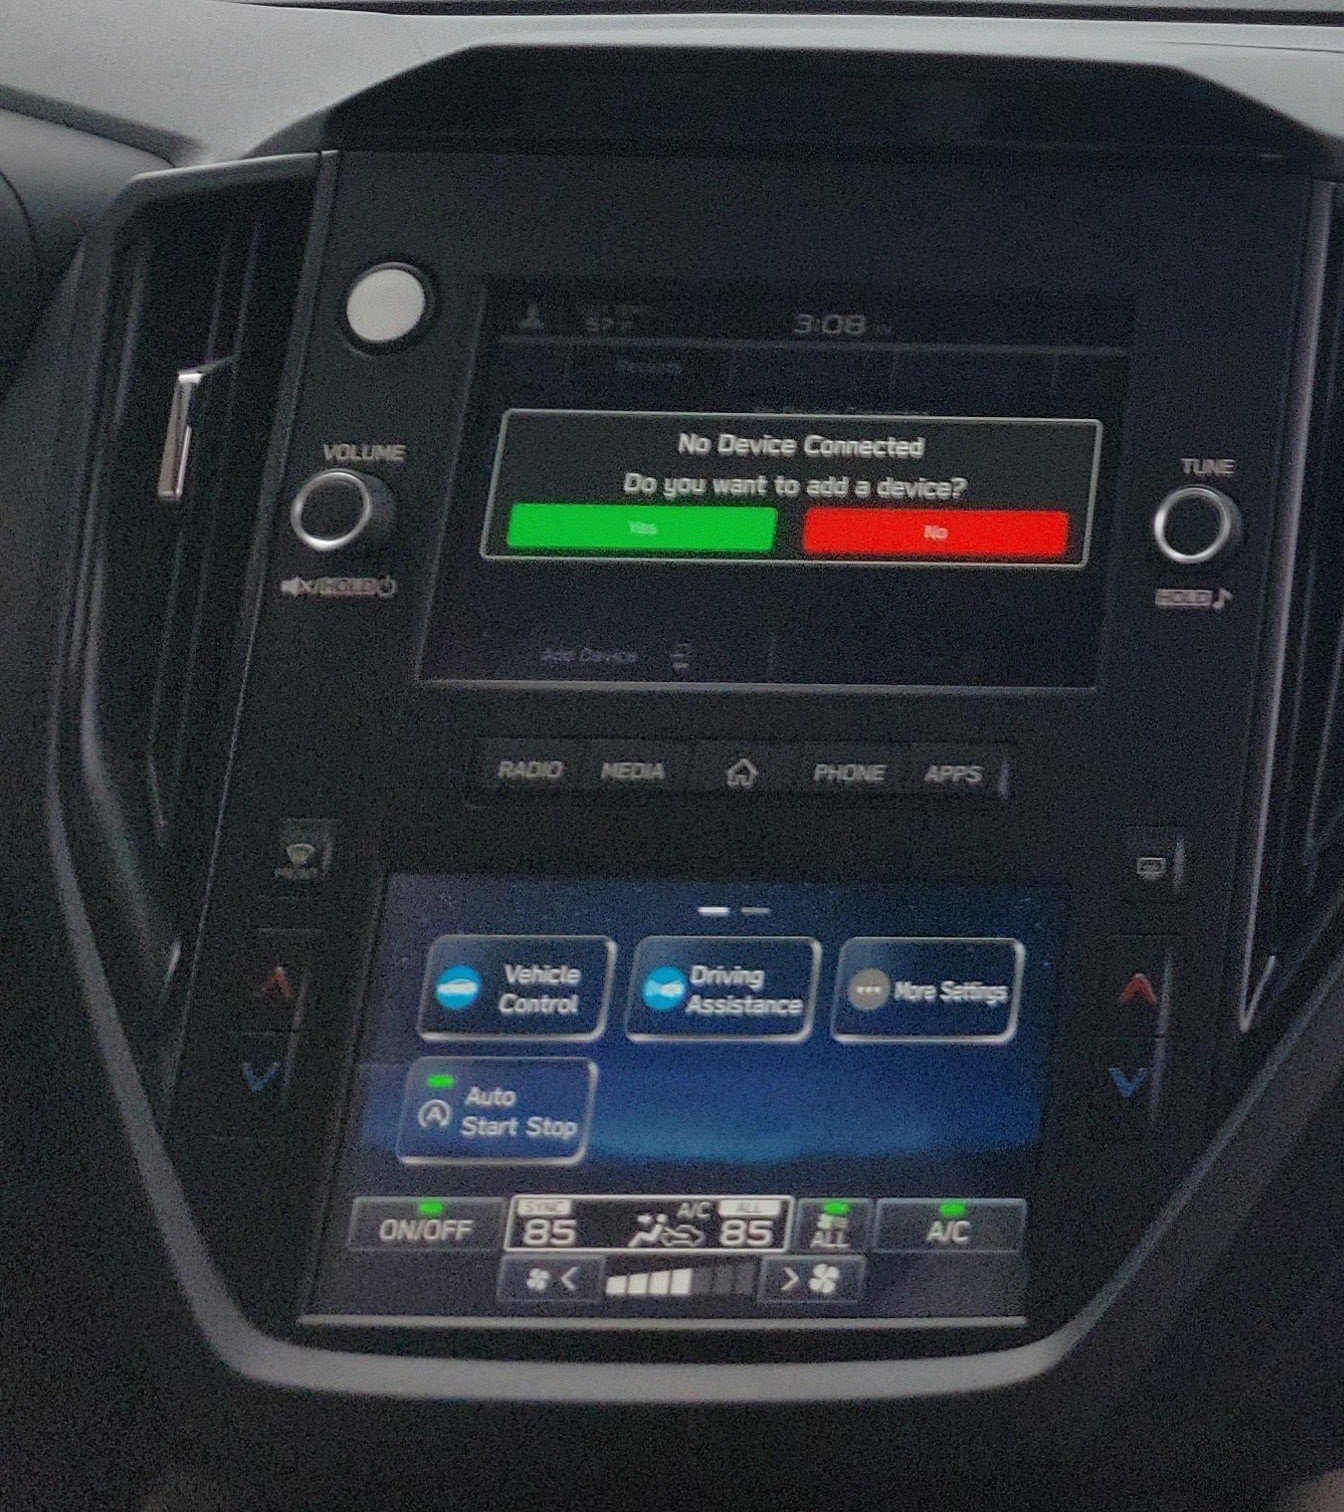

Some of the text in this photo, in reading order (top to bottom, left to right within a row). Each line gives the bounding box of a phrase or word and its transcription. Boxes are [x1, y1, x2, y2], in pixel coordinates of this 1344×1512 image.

[793, 314, 868, 335] 3:08
[323, 443, 407, 462] VOLUME
[678, 433, 926, 459] No Device Connected
[1180, 458, 1237, 475] TUNE
[623, 472, 969, 500] Do you want to add a device?
[923, 524, 948, 540] No
[497, 760, 565, 781] RADIO
[600, 761, 666, 781] MEDIA
[813, 763, 888, 783] PHONE
[924, 764, 985, 784] APPS
[504, 963, 582, 986] Vehicle
[690, 965, 766, 990] Driving
[499, 993, 579, 1015] Control
[894, 981, 1009, 1007] More Settings
[685, 995, 806, 1016] Assistance
[465, 1087, 517, 1107] Auto
[460, 1116, 579, 1141] Start Stop
[677, 1201, 711, 1221] A/C
[379, 1219, 474, 1242] ON/OFF
[522, 1218, 577, 1247] 85
[718, 1219, 774, 1248] 85
[810, 1231, 851, 1249] ALL
[926, 1220, 972, 1245] A/C
